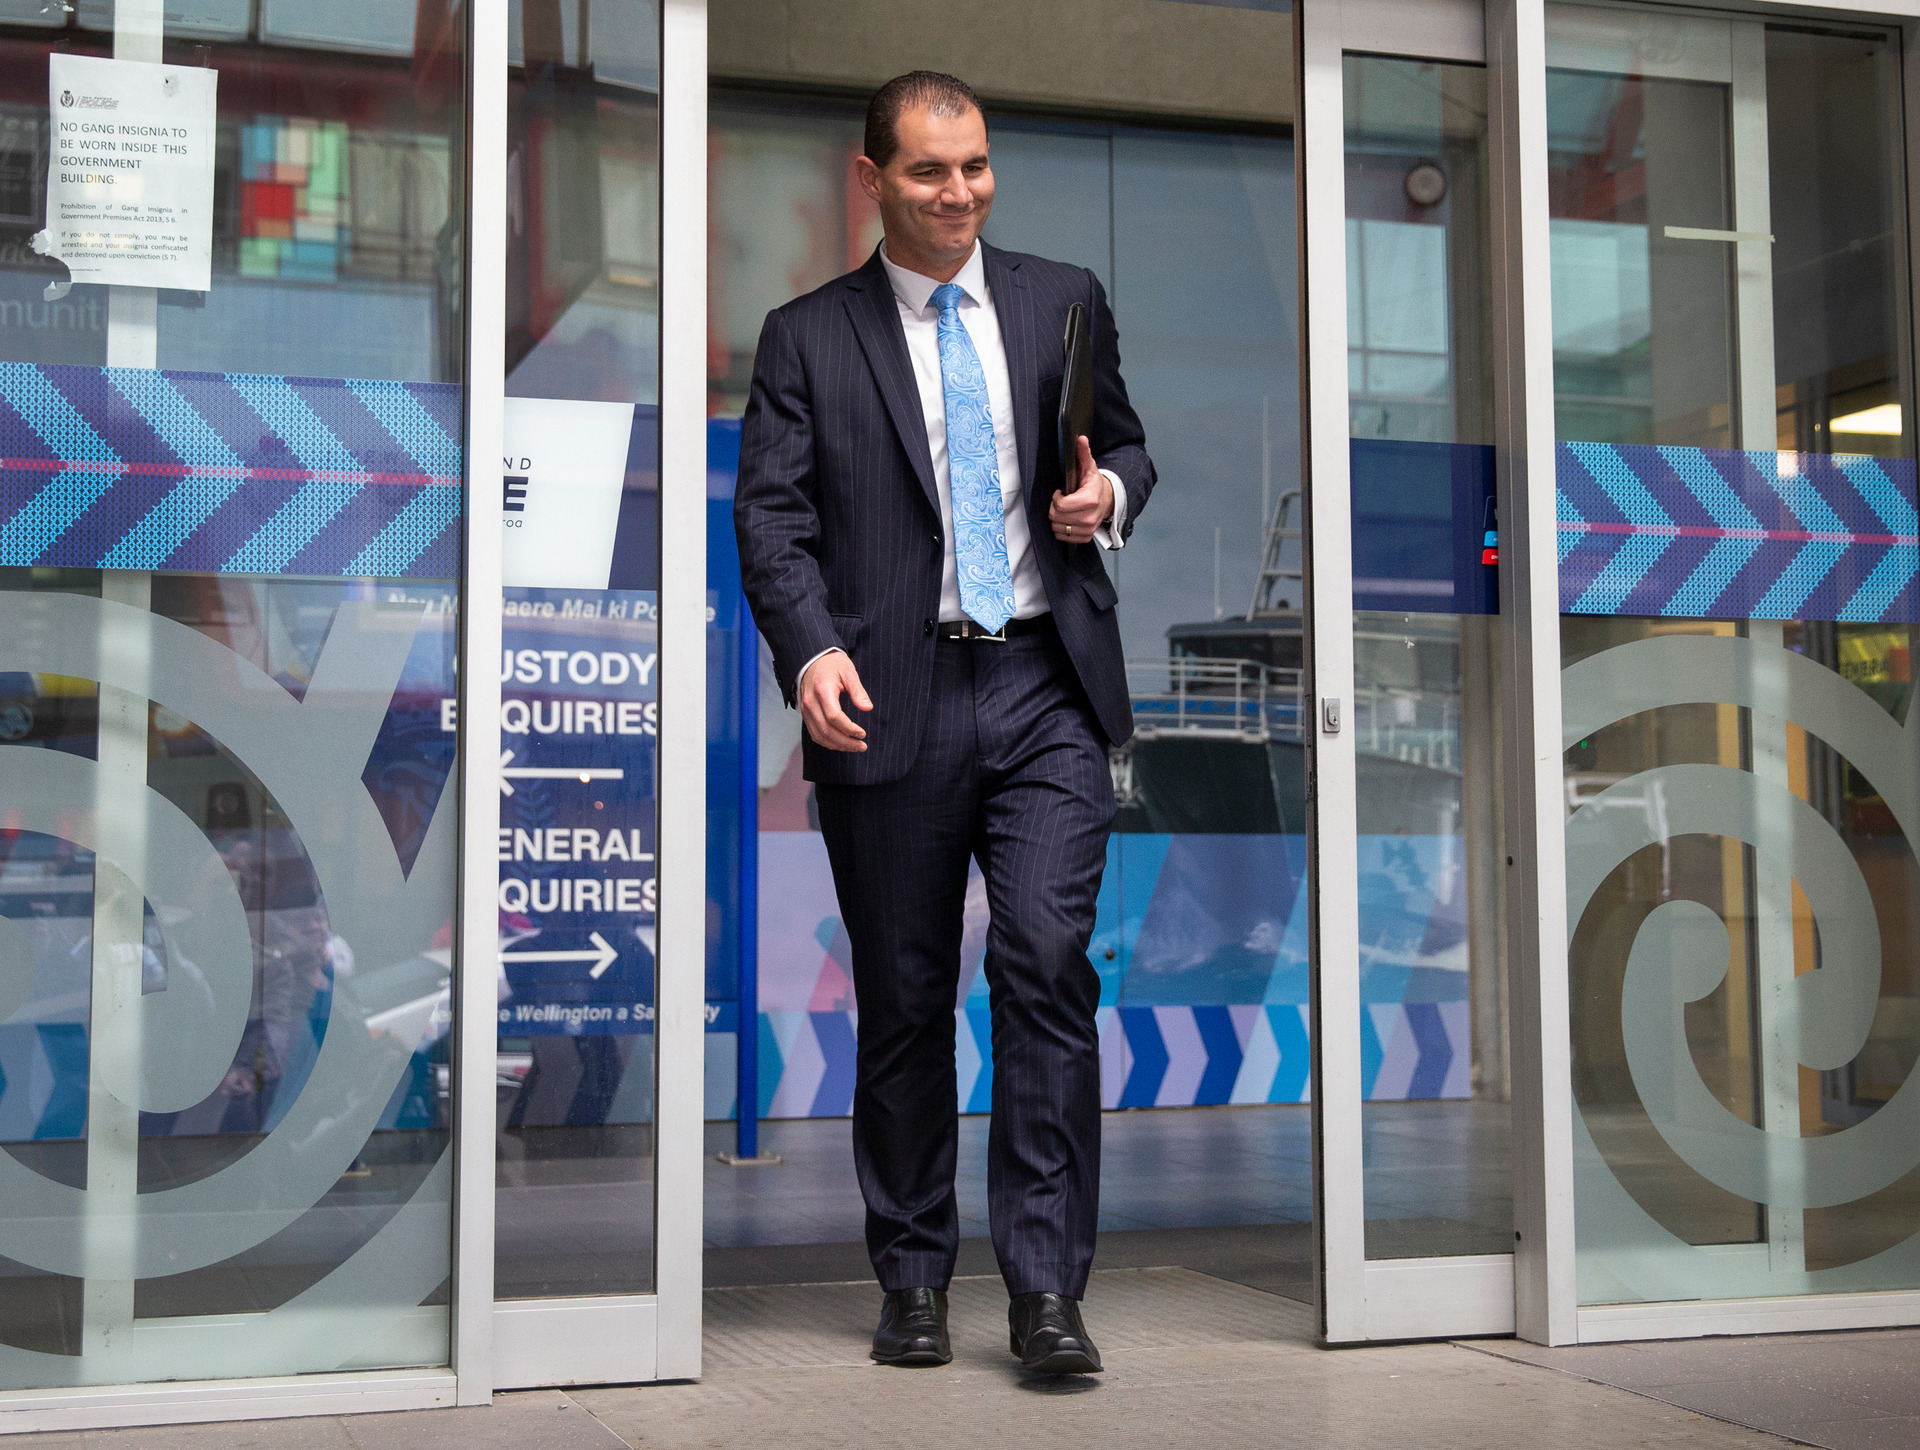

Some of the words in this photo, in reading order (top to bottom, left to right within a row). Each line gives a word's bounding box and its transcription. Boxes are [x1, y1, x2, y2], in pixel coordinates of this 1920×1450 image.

[60, 122, 78, 132] NO
[81, 123, 115, 134] GANG
[118, 125, 169, 137] INSIGNIA
[171, 127, 188, 138] TO
[60, 139, 74, 149] BE
[79, 140, 116, 151] WORN
[121, 142, 158, 153] INSIDE
[163, 144, 188, 155] THIS
[60, 156, 142, 169] GOVERNMENT
[60, 173, 118, 185] BUILDING.
[121, 204, 139, 213] Gang
[147, 206, 173, 214] Insignia
[61, 212, 101, 220] Government
[103, 213, 132, 222] Premises
[146, 215, 165, 224] 2013,
[69, 232, 82, 240] you
[85, 231, 95, 239] do
[114, 232, 141, 241] comply,
[144, 234, 158, 242] you
[161, 235, 176, 243] may
[179, 234, 188, 242] be
[90, 241, 103, 249] and
[123, 242, 149, 251] insignia
[150, 243, 188, 252] confiscated
[74, 251, 107, 260] destroyed
[108, 252, 126, 260] upon
[126, 252, 161, 260] conviction
[0, 295, 107, 331] munit
[501, 597, 555, 618] aere
[560, 598, 603, 620] Mai
[608, 599, 629, 621] ki
[453, 650, 657, 685] STODY
[499, 828, 655, 862] ENERAL
[499, 878, 656, 914] QUIRIES
[515, 1003, 613, 1025] Wellington
[616, 1007, 629, 1021] a
